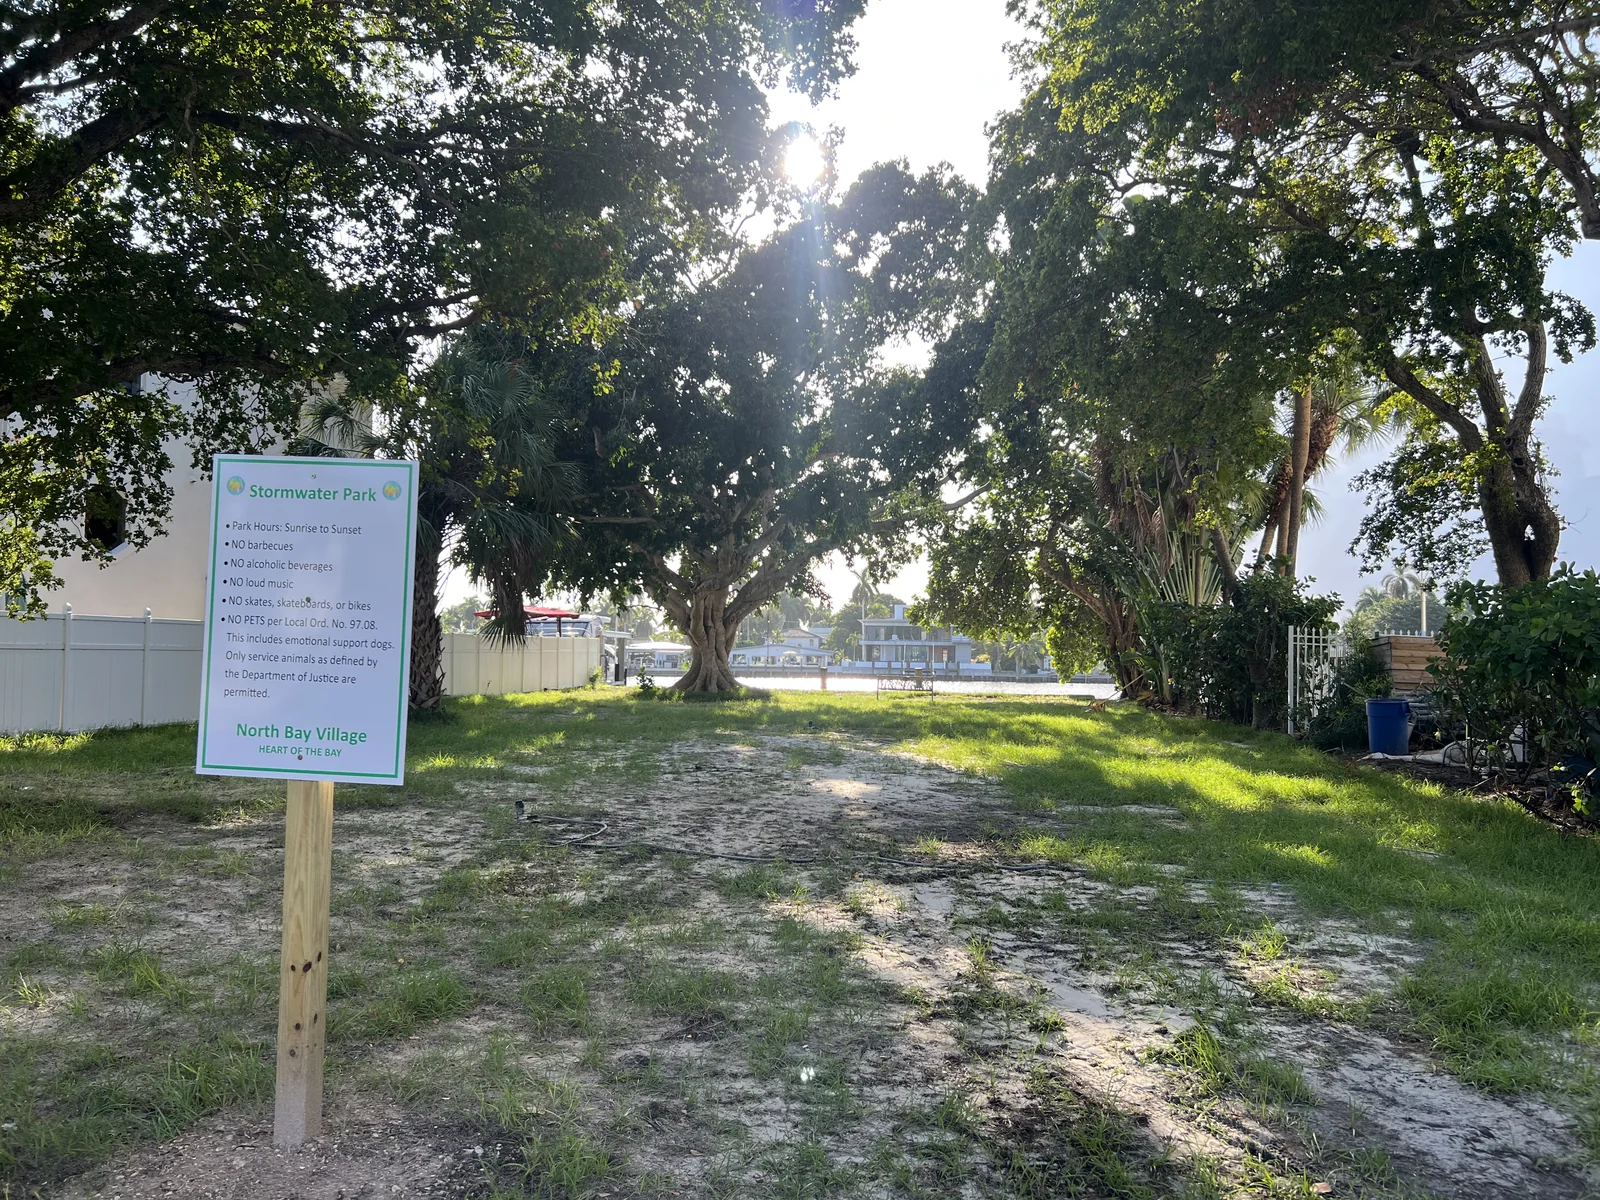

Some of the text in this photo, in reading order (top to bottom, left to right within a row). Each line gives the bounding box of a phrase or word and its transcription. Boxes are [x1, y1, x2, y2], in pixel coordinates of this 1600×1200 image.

[249, 484, 377, 502] Stormwater Park
[232, 521, 362, 535] Park Hours: Sunrise to Sunset
[231, 539, 294, 551] NO barbecues
[230, 558, 333, 573] NO alcoholic beverages
[229, 577, 294, 589] NO loud music
[228, 596, 372, 611] NO skates, skateboards, or bikes
[227, 615, 378, 630] NO PETS per Local Ord. No. 97.08.
[226, 632, 395, 651] This includes emotional support dogs.
[225, 650, 378, 669] Only service animals as defined by
[224, 669, 357, 684] the Department of Justice are
[223, 687, 270, 699] permitted.
[236, 723, 368, 746] North Bay Village
[258, 745, 342, 757] HEART OF THE BAY
